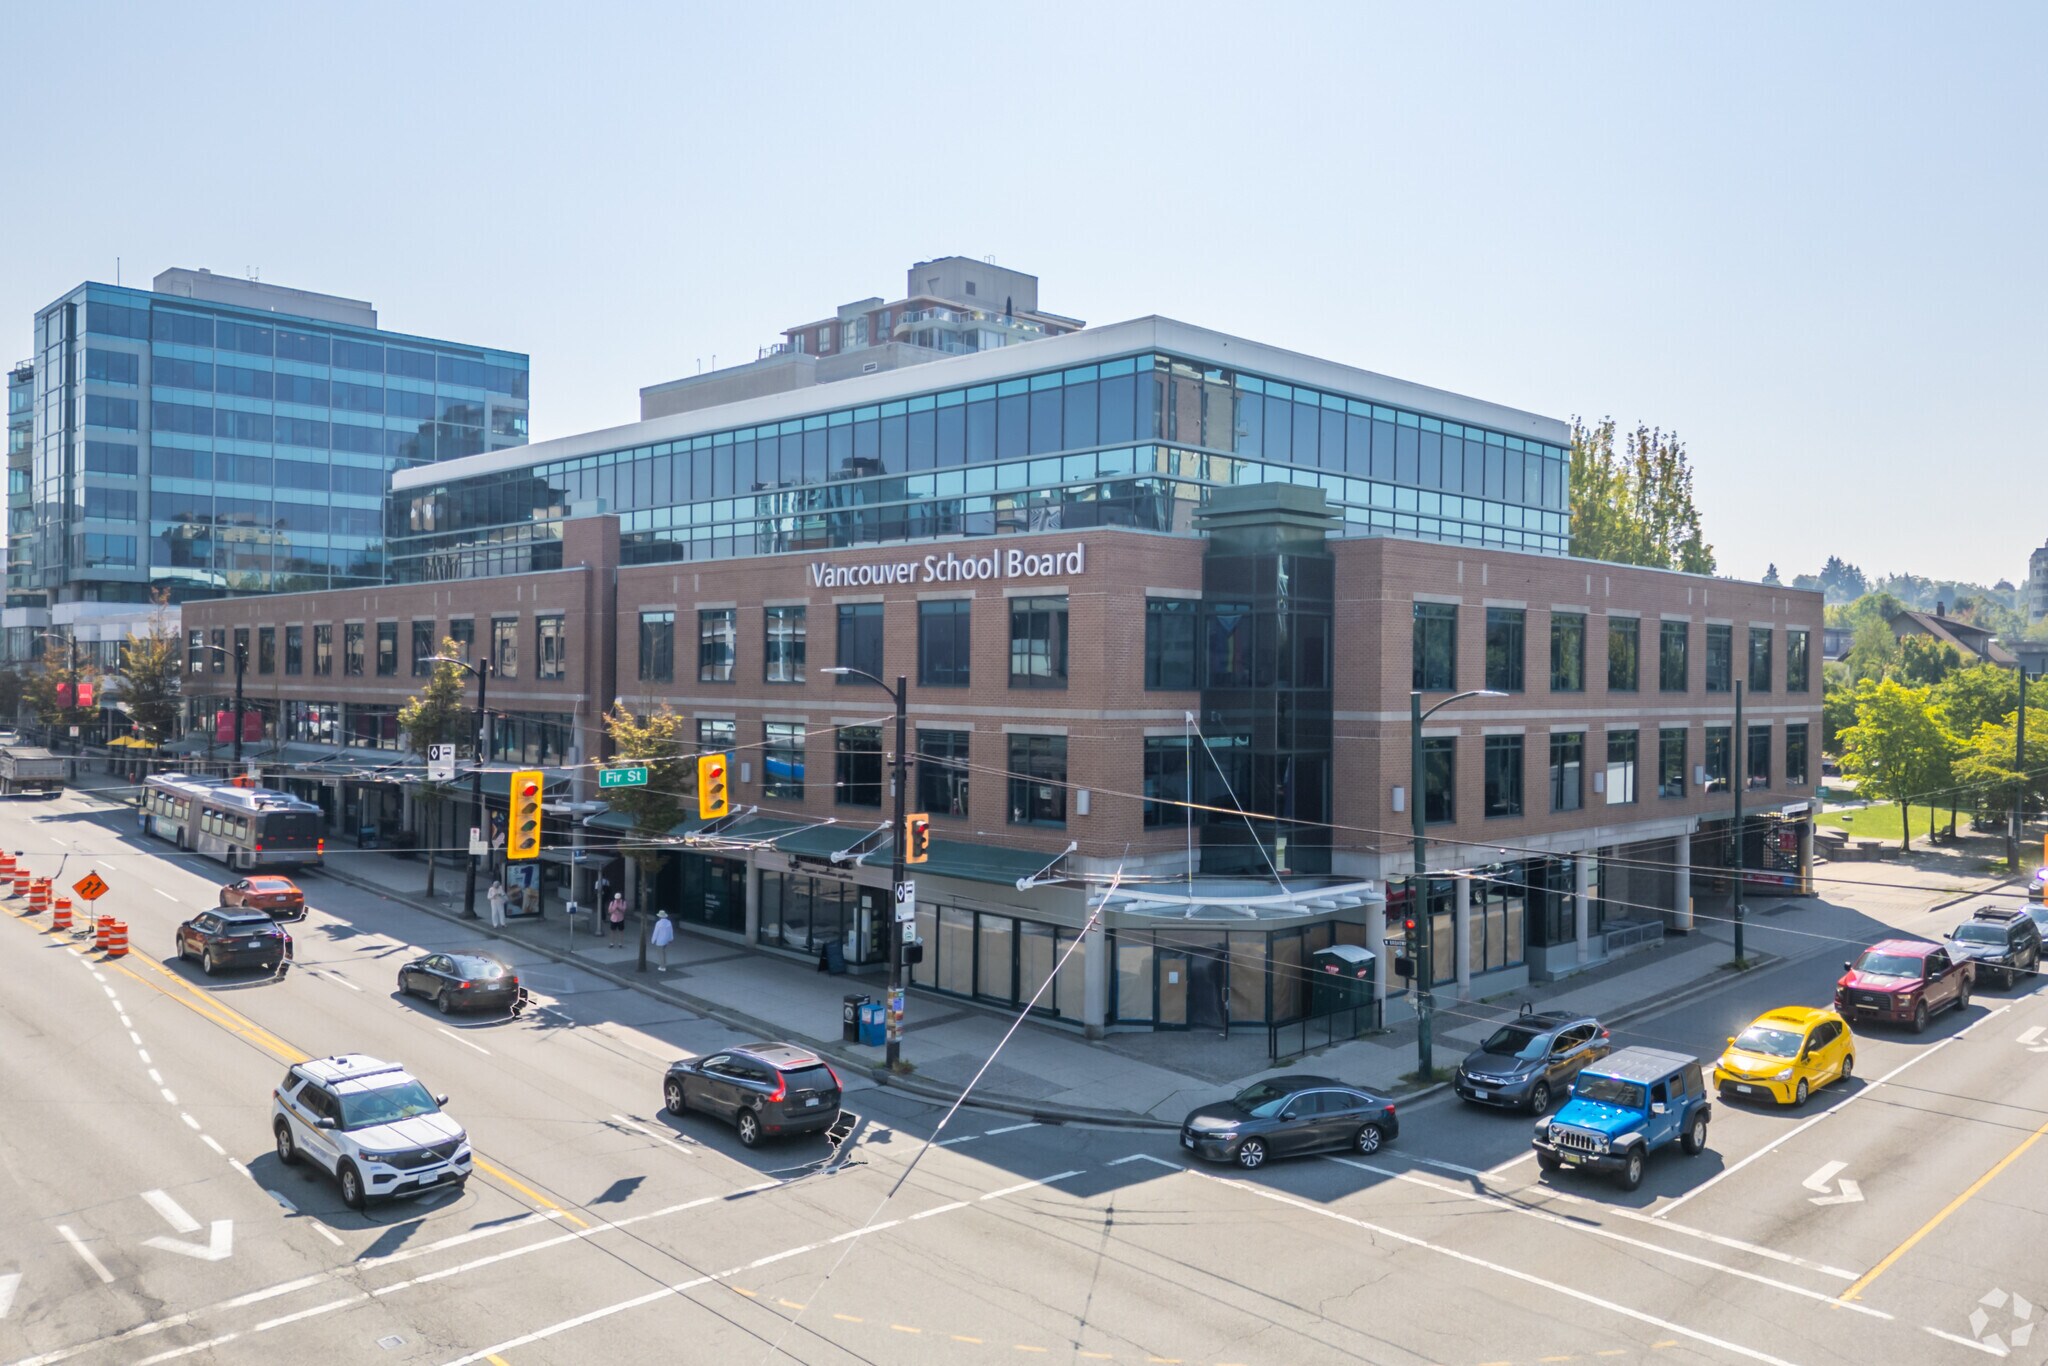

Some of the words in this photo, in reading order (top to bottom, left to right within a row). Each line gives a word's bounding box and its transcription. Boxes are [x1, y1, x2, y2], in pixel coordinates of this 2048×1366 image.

[811, 562, 919, 588] Vancouver
[922, 548, 999, 583] School
[1007, 542, 1085, 578] Board
[605, 771, 622, 783] Fir
[627, 770, 641, 782] St
